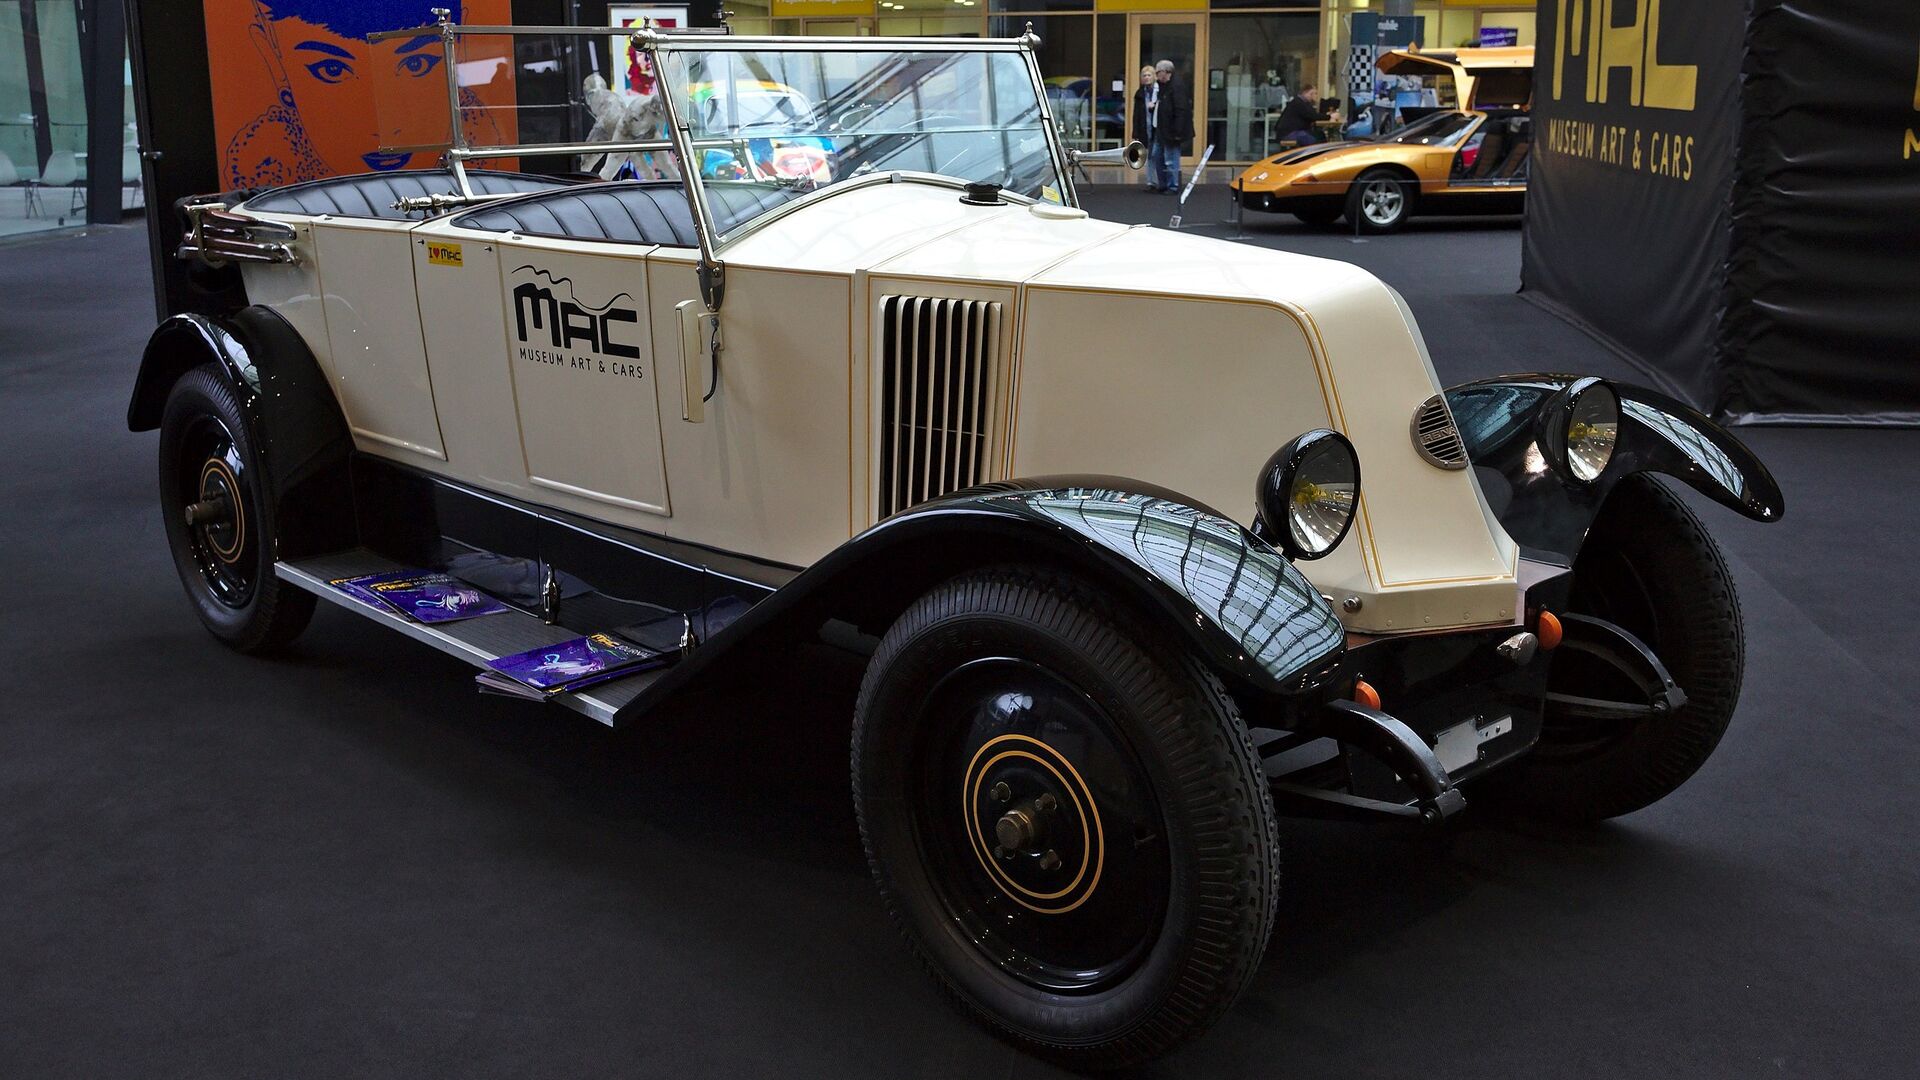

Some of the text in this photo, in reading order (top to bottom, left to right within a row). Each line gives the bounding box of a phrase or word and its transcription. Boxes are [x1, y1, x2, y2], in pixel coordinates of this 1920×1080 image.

[1549, 118, 1694, 182] MUSEUM ART & CARS
[440, 247, 462, 262] MAC
[513, 282, 640, 359] MAC
[519, 347, 643, 379] MUSEUM ART & CARS
